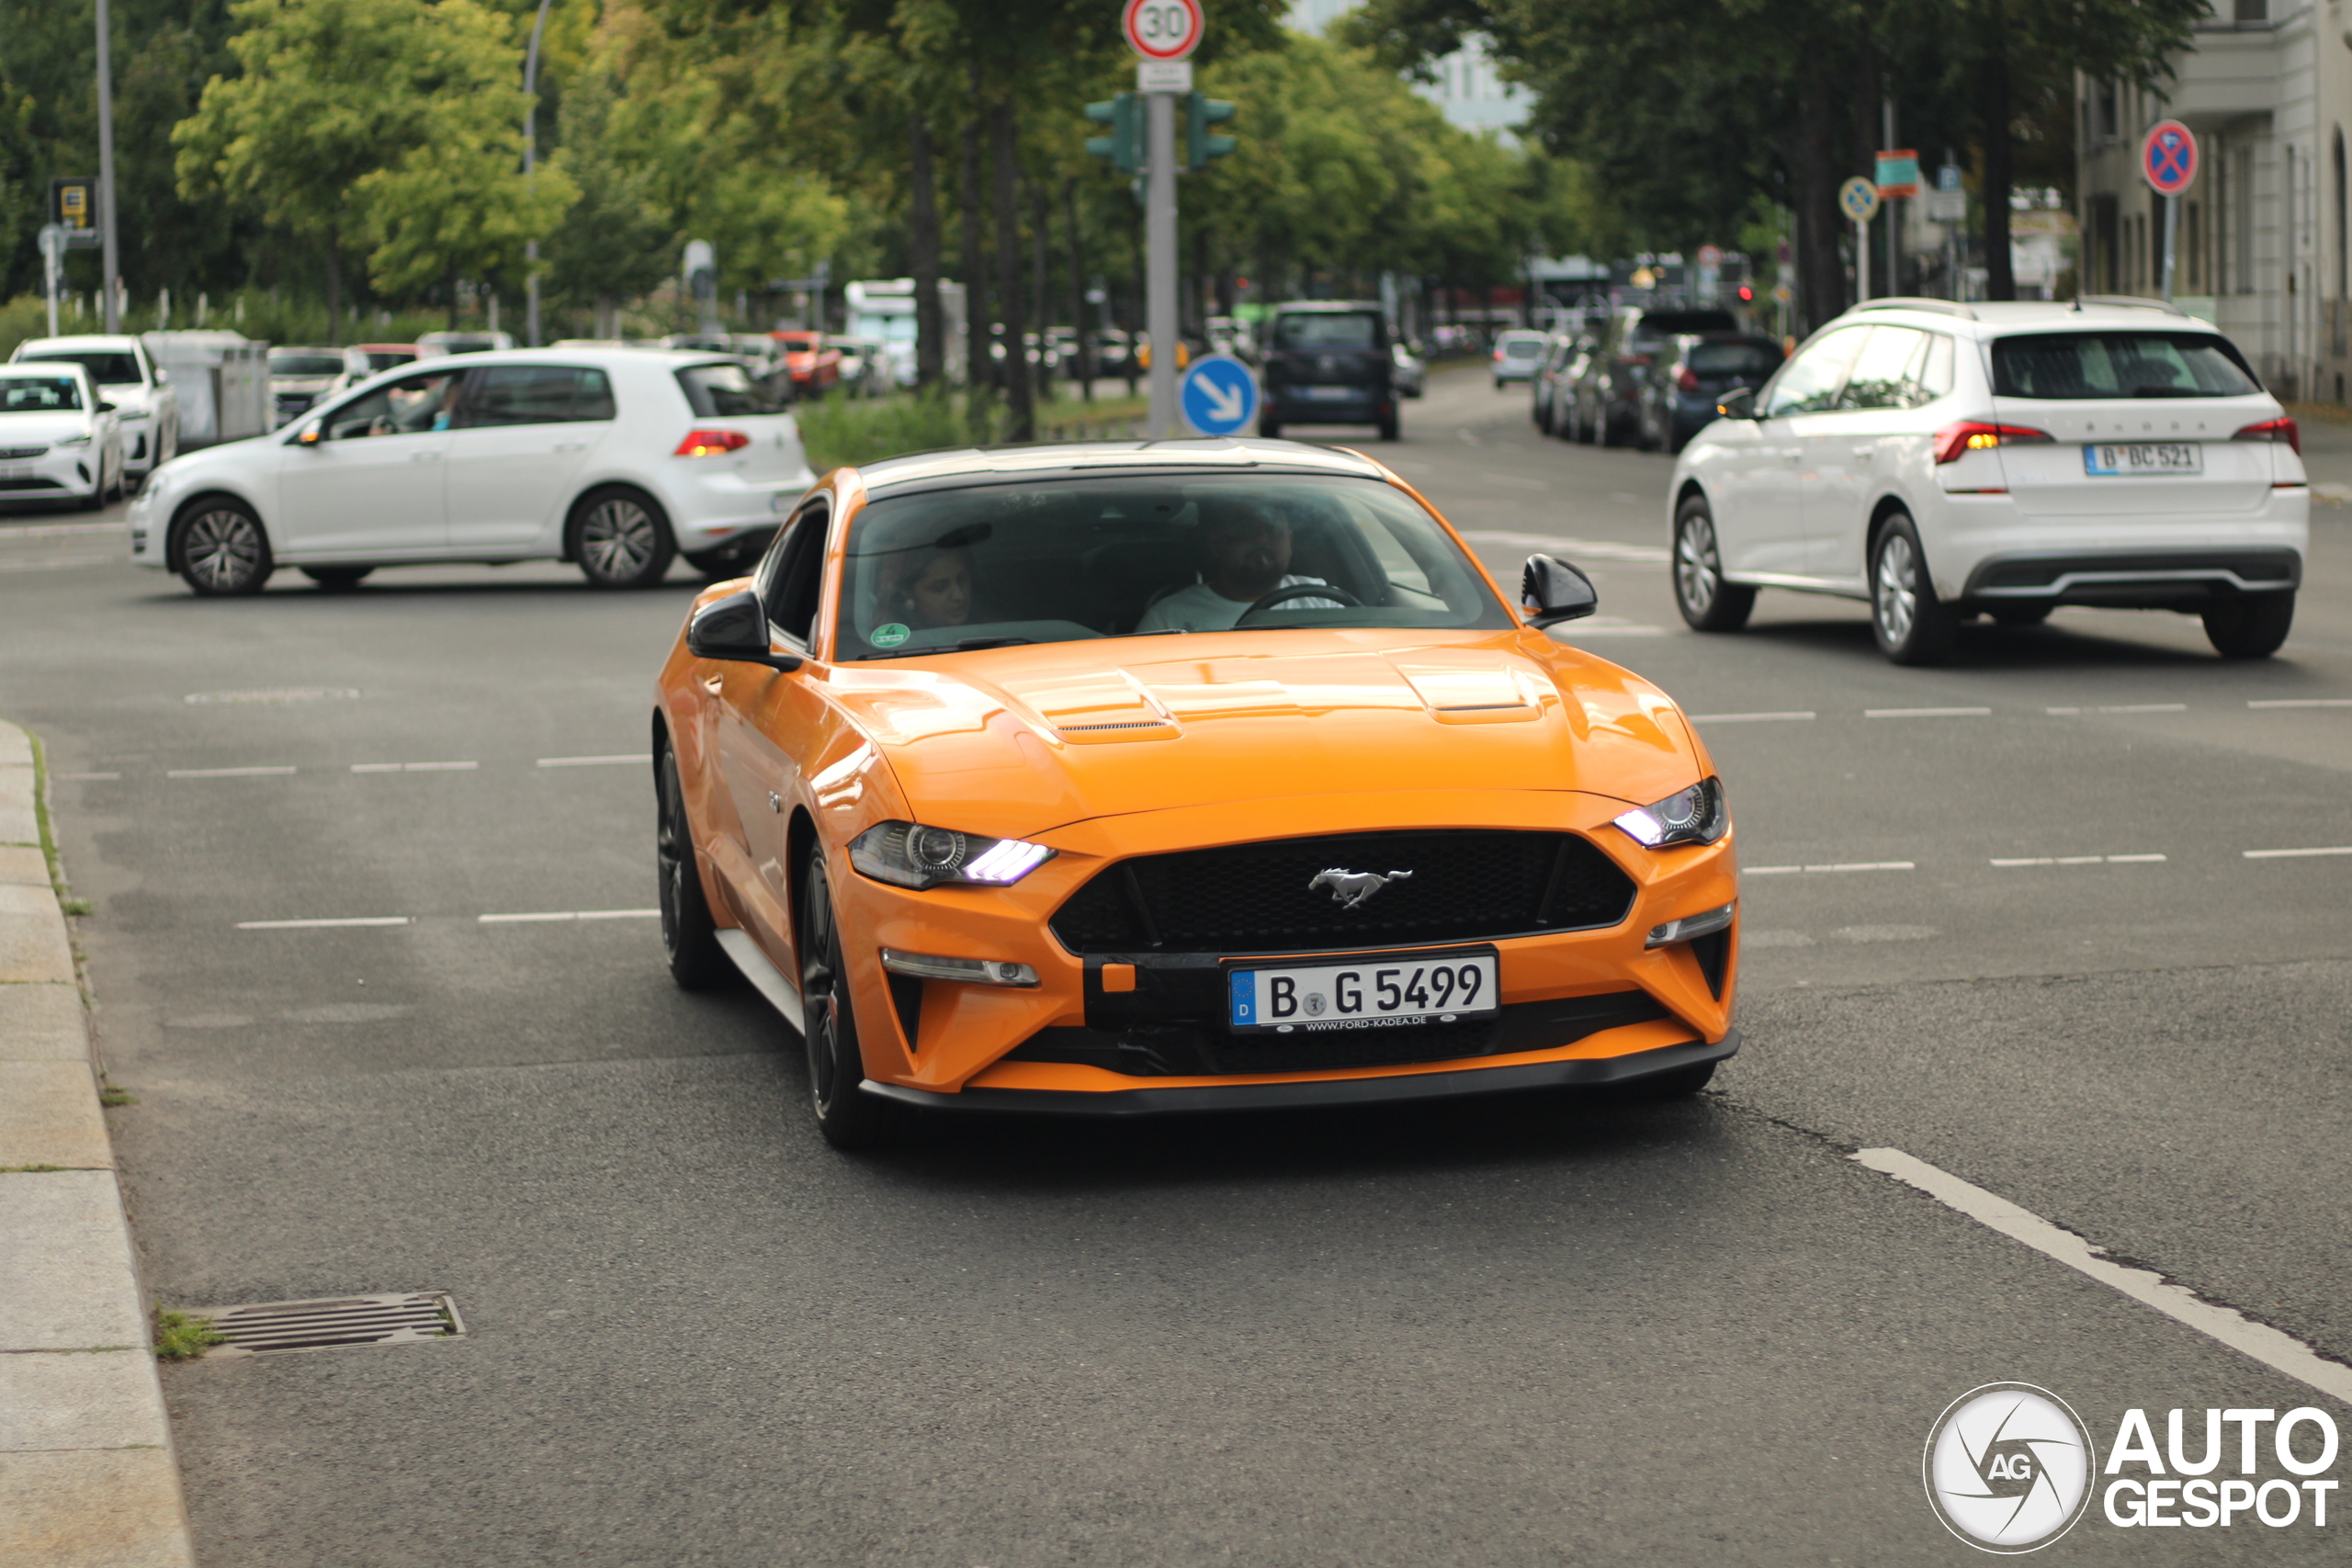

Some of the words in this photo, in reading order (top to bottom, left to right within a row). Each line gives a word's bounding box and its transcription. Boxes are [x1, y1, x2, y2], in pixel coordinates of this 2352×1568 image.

[1143, 6, 1184, 38] 30
[2104, 447, 2116, 467] B
[2129, 446, 2154, 466] BC
[2158, 446, 2193, 466] 521
[886, 625, 896, 635] 4
[1271, 976, 1298, 1018] B
[1336, 971, 1363, 1013] G
[1375, 964, 1482, 1011] 5499
[1239, 1004, 1250, 1016] D
[1306, 1016, 1427, 1031] WWW.FORD-KADEA.DE
